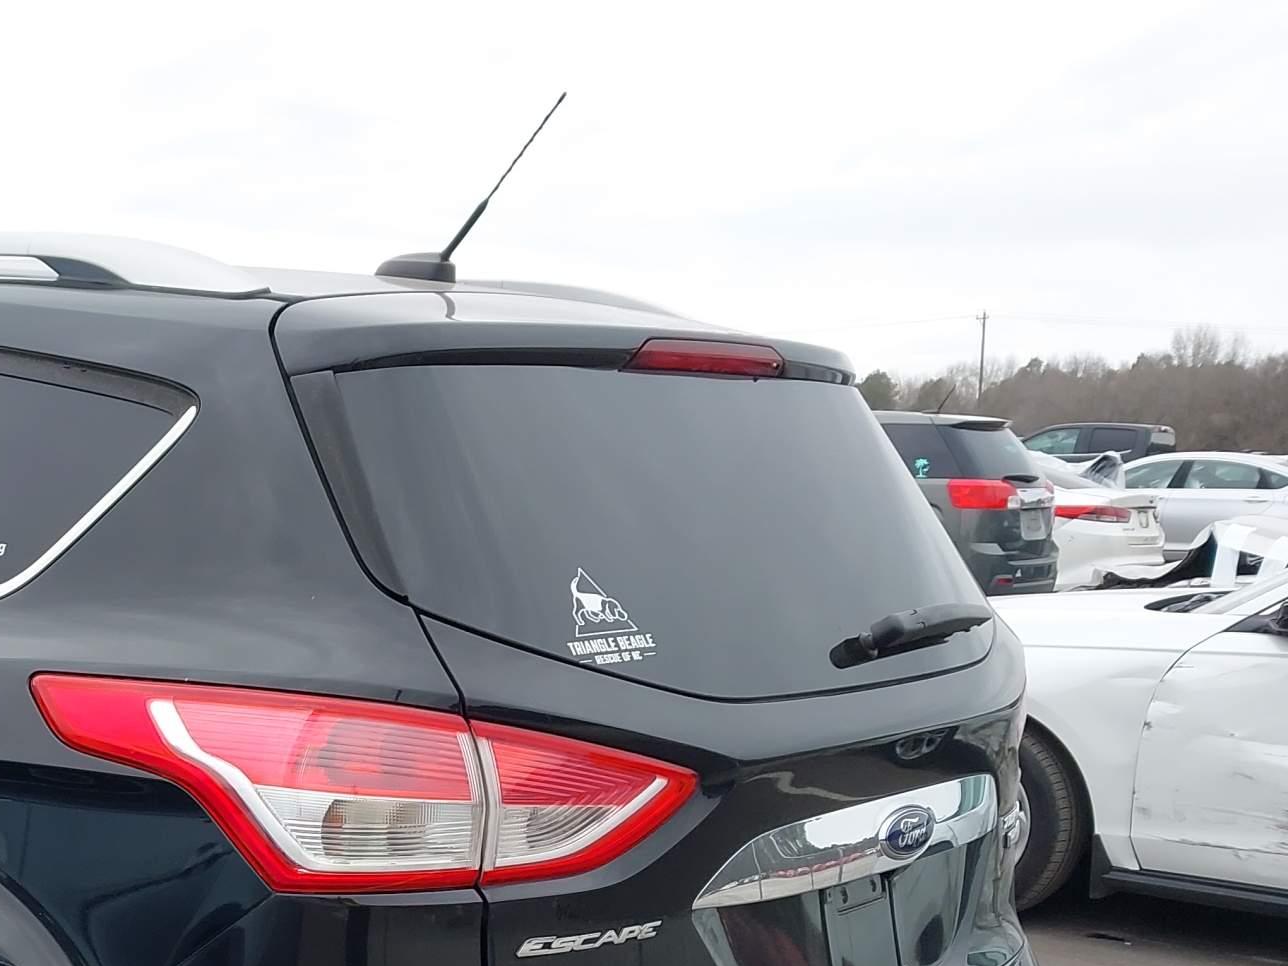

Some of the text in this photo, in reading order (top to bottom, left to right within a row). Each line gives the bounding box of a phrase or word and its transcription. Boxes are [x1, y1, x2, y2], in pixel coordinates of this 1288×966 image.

[567, 633, 657, 656] TRIANGLE BEAGLE
[594, 652, 623, 665] RESCUE
[621, 651, 631, 662] OF
[898, 816, 927, 848] Ford
[516, 920, 662, 958] ESCAPE
